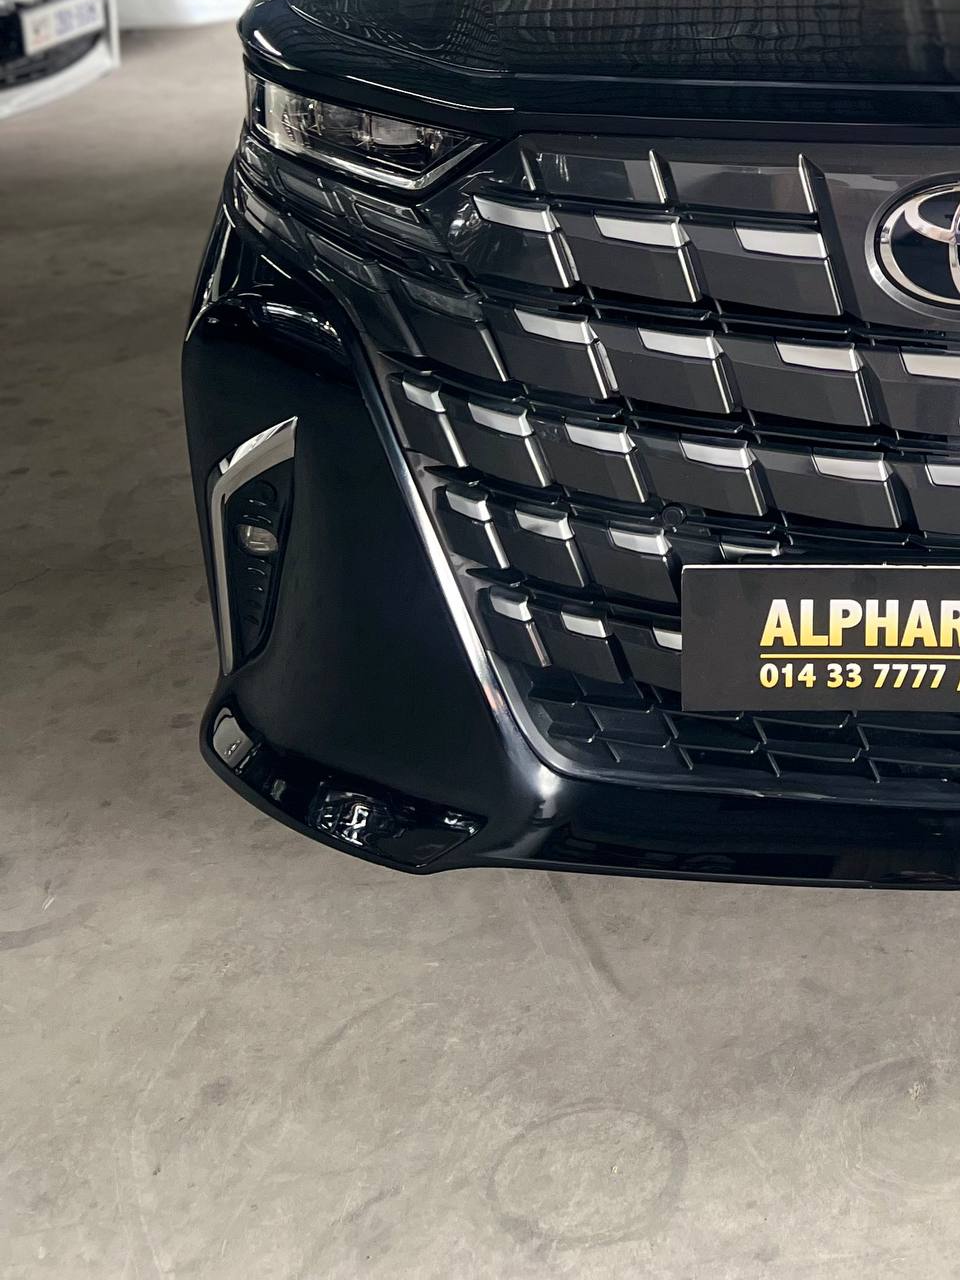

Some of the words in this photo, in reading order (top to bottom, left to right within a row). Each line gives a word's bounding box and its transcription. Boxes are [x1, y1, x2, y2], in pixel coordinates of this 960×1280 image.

[759, 662, 817, 689] 014
[826, 662, 863, 689] 33
[872, 663, 947, 689] 7777
